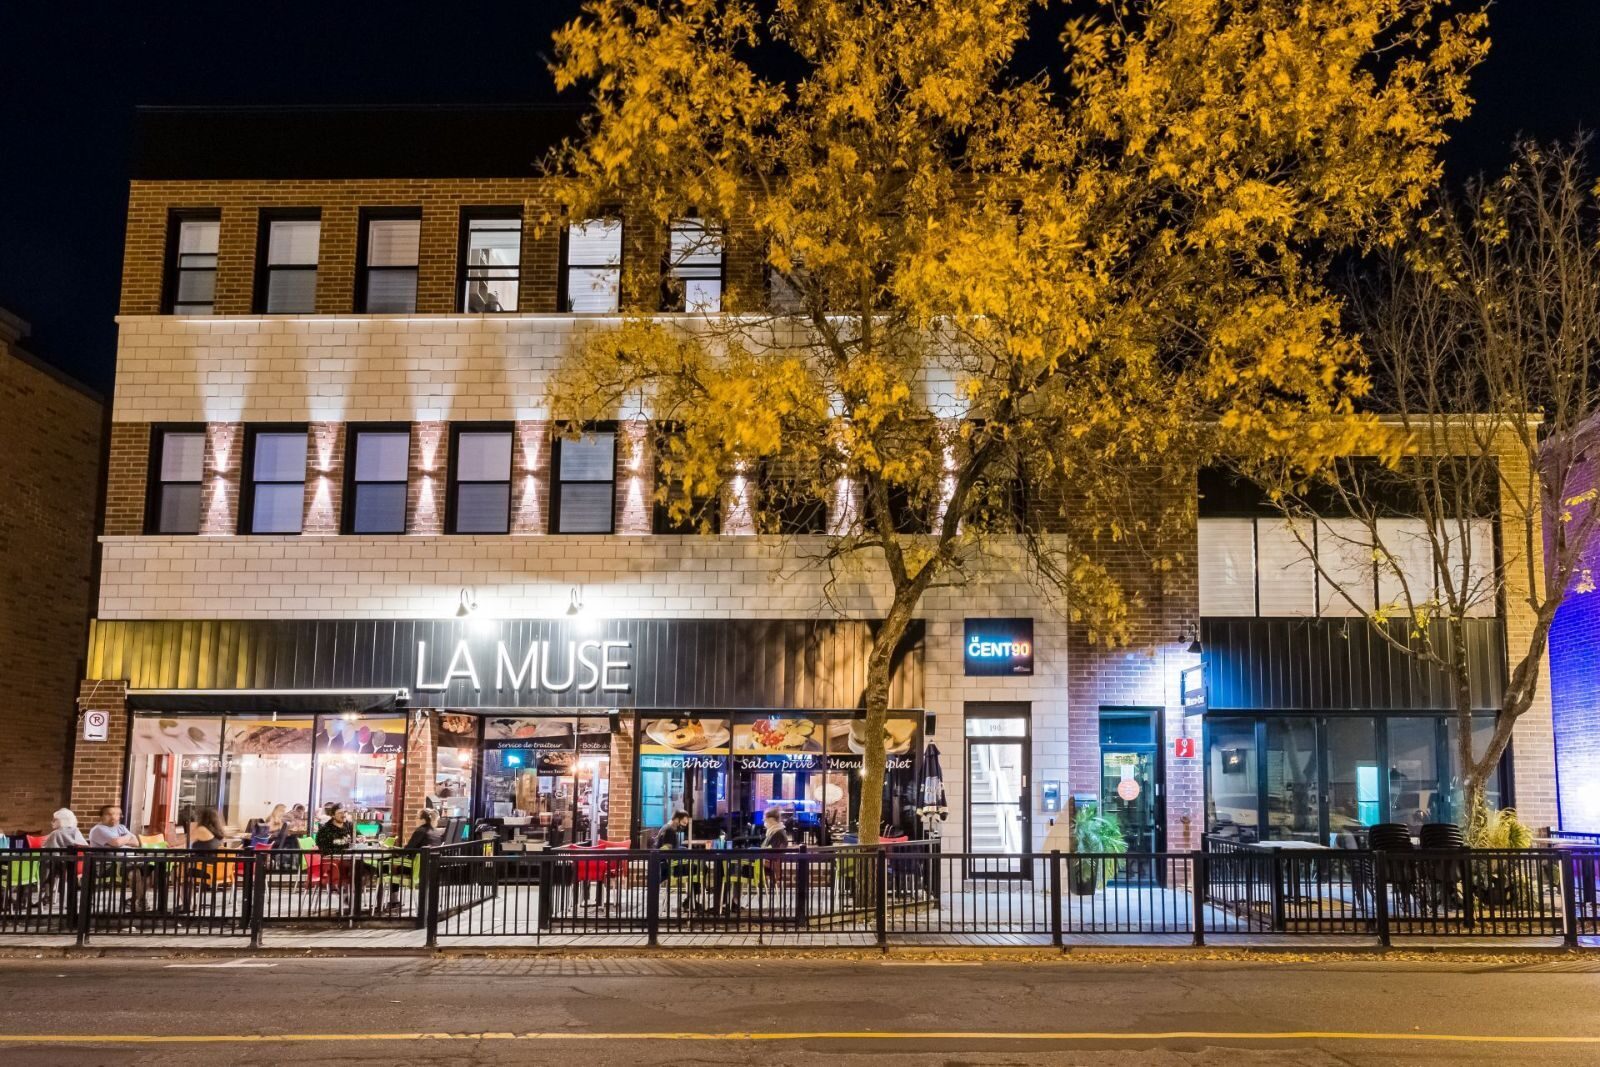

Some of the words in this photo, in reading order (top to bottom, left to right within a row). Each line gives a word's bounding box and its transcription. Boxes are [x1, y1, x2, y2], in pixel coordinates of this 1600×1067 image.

[968, 642, 1030, 657] CENT90
[415, 640, 480, 690] LA
[495, 640, 630, 691] MUSE
[682, 757, 723, 769] d'hôte
[741, 757, 781, 769] Salon
[886, 757, 912, 772] plet
